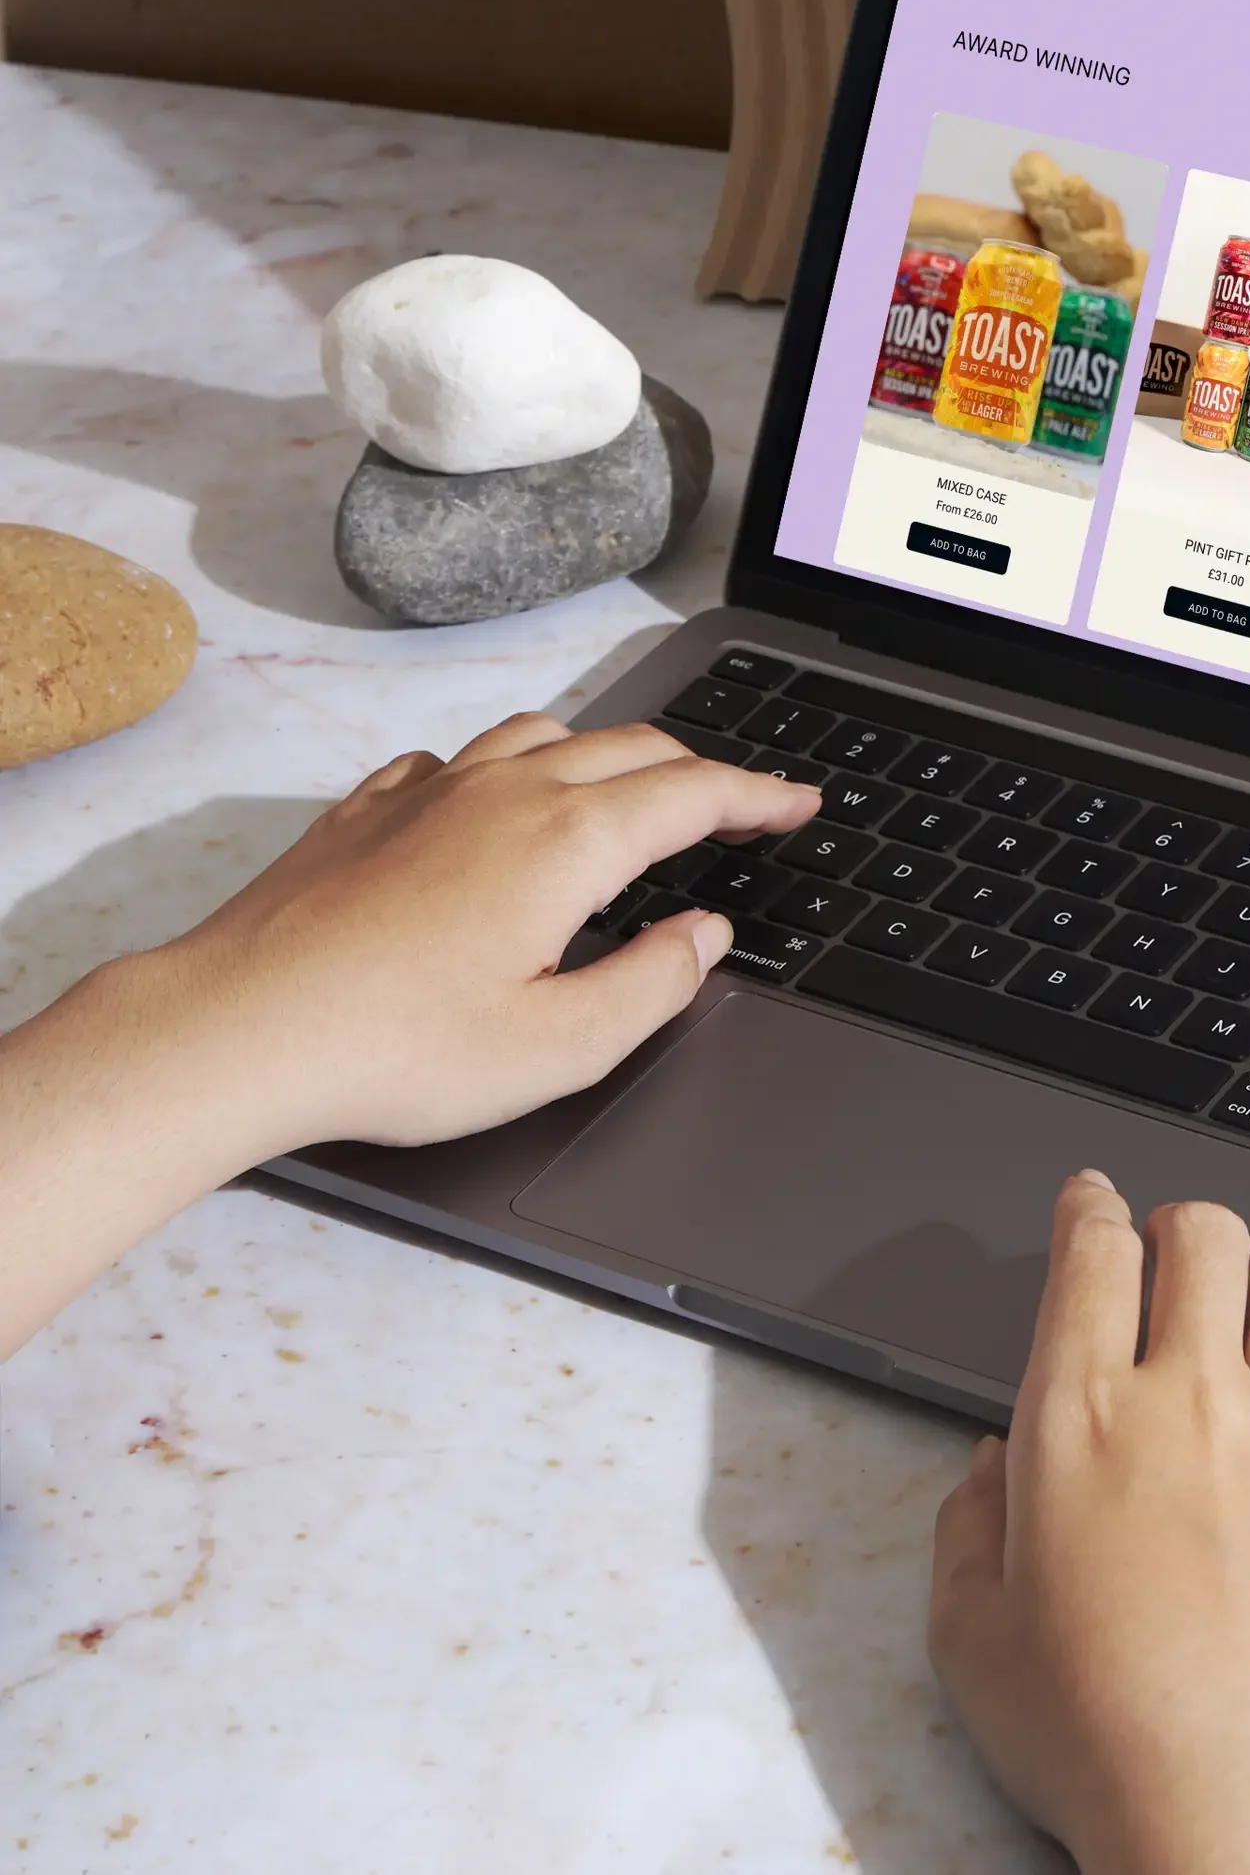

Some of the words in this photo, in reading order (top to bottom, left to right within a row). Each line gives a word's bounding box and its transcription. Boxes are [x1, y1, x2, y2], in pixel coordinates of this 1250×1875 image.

[952, 30, 1029, 63] AWARD
[1035, 47, 1132, 86] WINNING
[959, 311, 1045, 374] TOAST
[960, 360, 1030, 387] BREWING
[1045, 344, 1120, 400] TOAST
[967, 389, 993, 404] RISE
[1193, 380, 1240, 413] TOAST
[971, 401, 1003, 422] LAGER
[936, 477, 974, 497] MIXED
[976, 488, 1007, 506] CASE
[936, 500, 962, 517] From
[963, 507, 998, 526] £26.00
[930, 537, 950, 552] ADD
[952, 543, 965, 555] TO
[966, 547, 987, 561] BAG
[1184, 539, 1214, 557] PINT
[1215, 547, 1243, 565] GIFT
[1207, 568, 1245, 587] £31.00
[1188, 603, 1209, 616] ADD
[1211, 608, 1225, 621] TO
[1227, 613, 1247, 626] BAG
[729, 657, 754, 670] esc
[774, 724, 786, 735] 1
[846, 745, 863, 757] 2
[921, 767, 938, 779] 3
[843, 791, 867, 806] W
[998, 789, 1015, 801] 4
[921, 814, 940, 827] E
[1076, 811, 1094, 824] 5
[817, 841, 836, 854] S
[997, 837, 1017, 851] R
[1154, 834, 1172, 847] 6
[893, 864, 912, 877] D
[1081, 860, 1098, 873] T
[730, 875, 751, 888] Z
[973, 888, 992, 900] F
[1161, 883, 1178, 896] Y
[807, 897, 829, 912] X
[1053, 912, 1072, 925] G
[888, 922, 907, 935] C
[1132, 935, 1155, 950] H
[725, 945, 787, 971] ommand
[970, 945, 988, 959] V
[1217, 962, 1235, 974] J
[1047, 970, 1067, 984] B
[1129, 995, 1152, 1010] N
[1211, 1019, 1237, 1036] M
